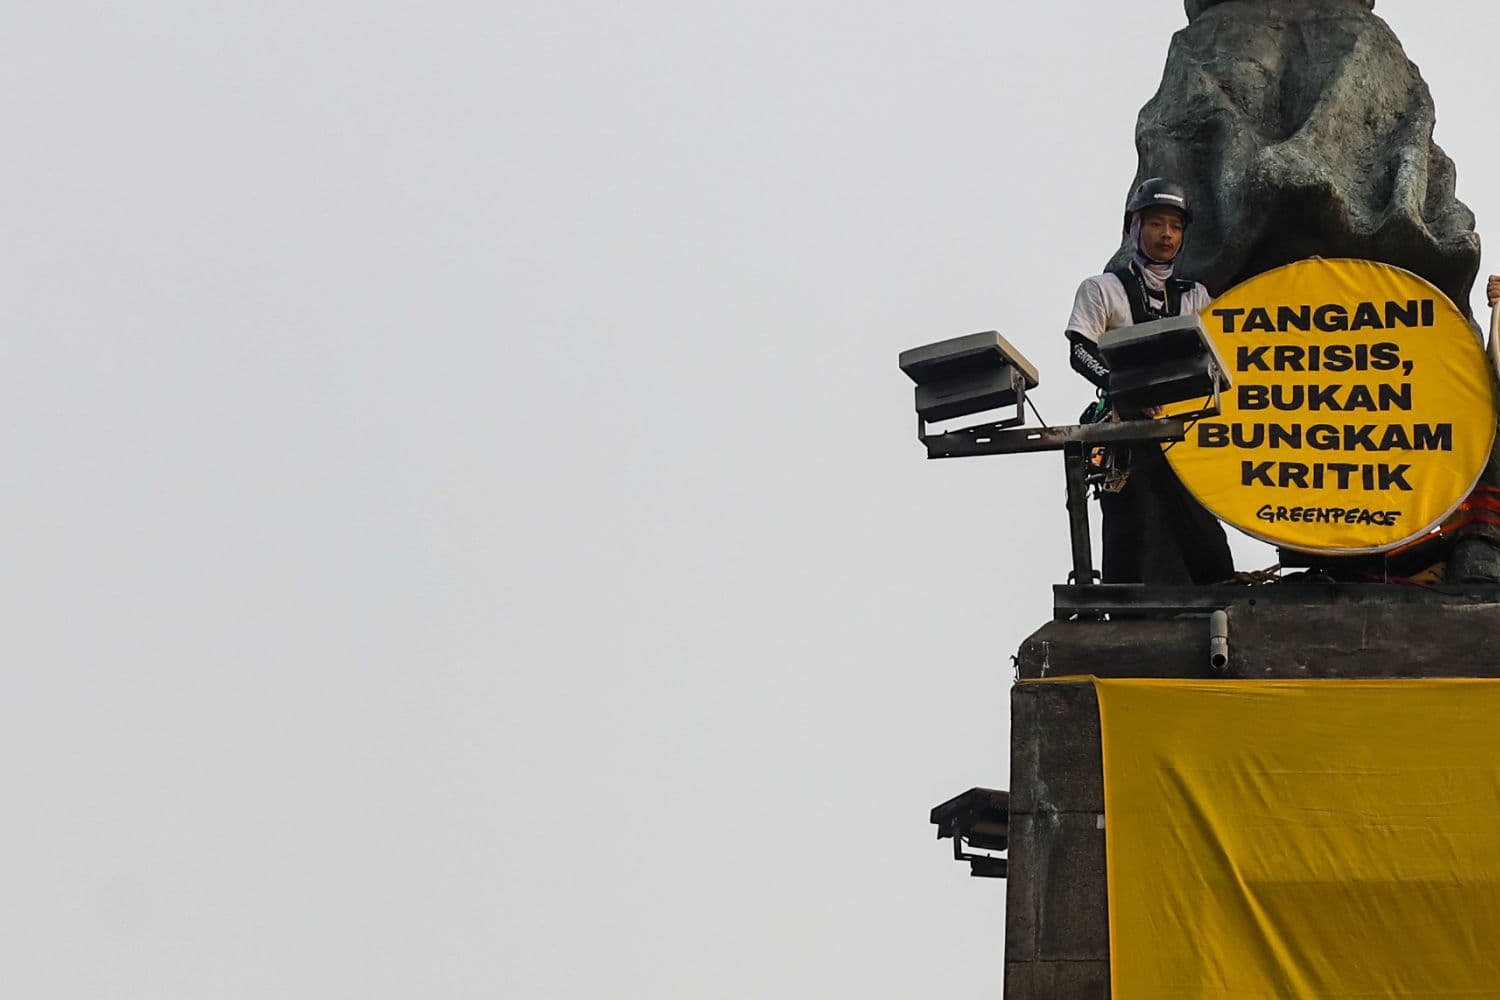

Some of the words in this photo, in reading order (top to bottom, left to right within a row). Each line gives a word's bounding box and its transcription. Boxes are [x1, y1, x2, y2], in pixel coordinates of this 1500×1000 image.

[1211, 298, 1434, 334] TANGANI
[1236, 342, 1414, 376] KRISIS,
[1238, 383, 1412, 411] BUKAN
[1198, 423, 1453, 452] BUNGKAM
[1241, 460, 1414, 491] KRITIK
[1256, 504, 1402, 527] GREENPEACE
